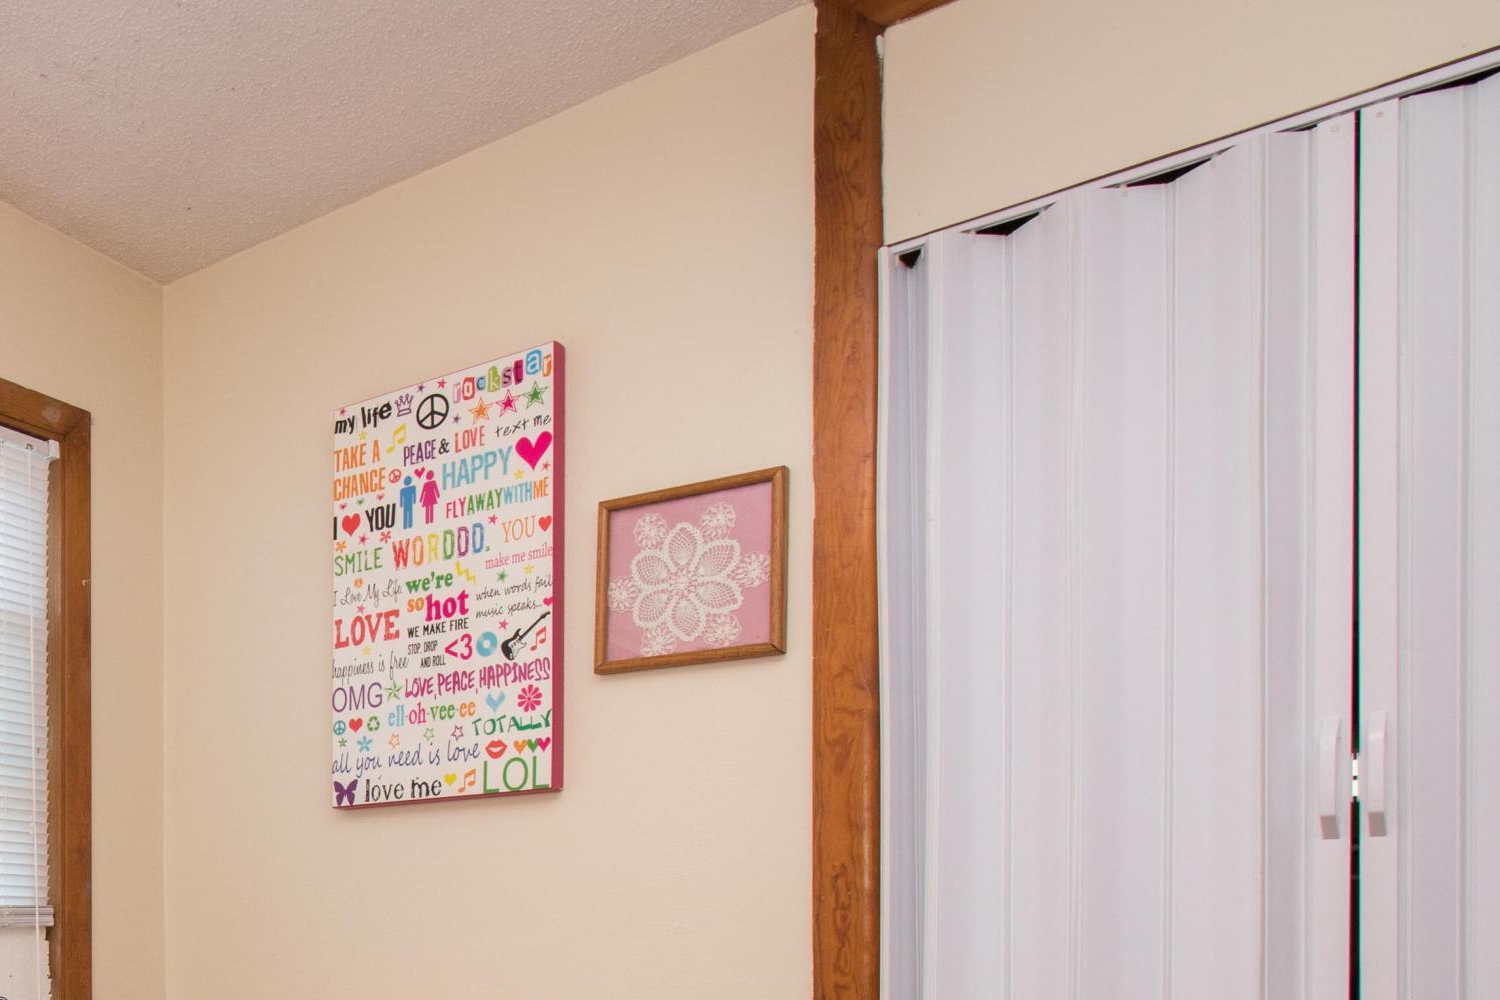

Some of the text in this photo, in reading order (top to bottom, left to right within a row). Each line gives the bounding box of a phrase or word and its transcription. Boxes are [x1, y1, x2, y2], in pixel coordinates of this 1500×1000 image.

[453, 349, 552, 404] rockstar
[334, 401, 392, 435] my life
[533, 414, 552, 427] me
[334, 440, 381, 473] TAKE A
[403, 426, 485, 467] PEACE & LOVE
[333, 467, 386, 501] CHANCE
[442, 446, 512, 491] HAPPY
[333, 503, 396, 541] I YOU
[502, 515, 536, 544] YOU
[334, 547, 383, 576] SMILE
[485, 542, 553, 570] make me smile
[405, 571, 453, 594] we're
[476, 573, 553, 601] when words fail
[407, 590, 469, 622] so hot
[476, 602, 503, 619] music
[334, 609, 400, 649] LOVE
[407, 617, 469, 638] WE MAKE FIRE
[420, 654, 446, 668] AND ROLL
[423, 640, 438, 653] DROP
[332, 650, 409, 686] happiness is free
[479, 656, 551, 690] HAPPINESS
[332, 682, 383, 713] OMG
[472, 708, 552, 736] TOTALLY
[332, 740, 480, 779] all you need is love
[483, 755, 549, 794] LOL
[364, 777, 442, 802] love me
